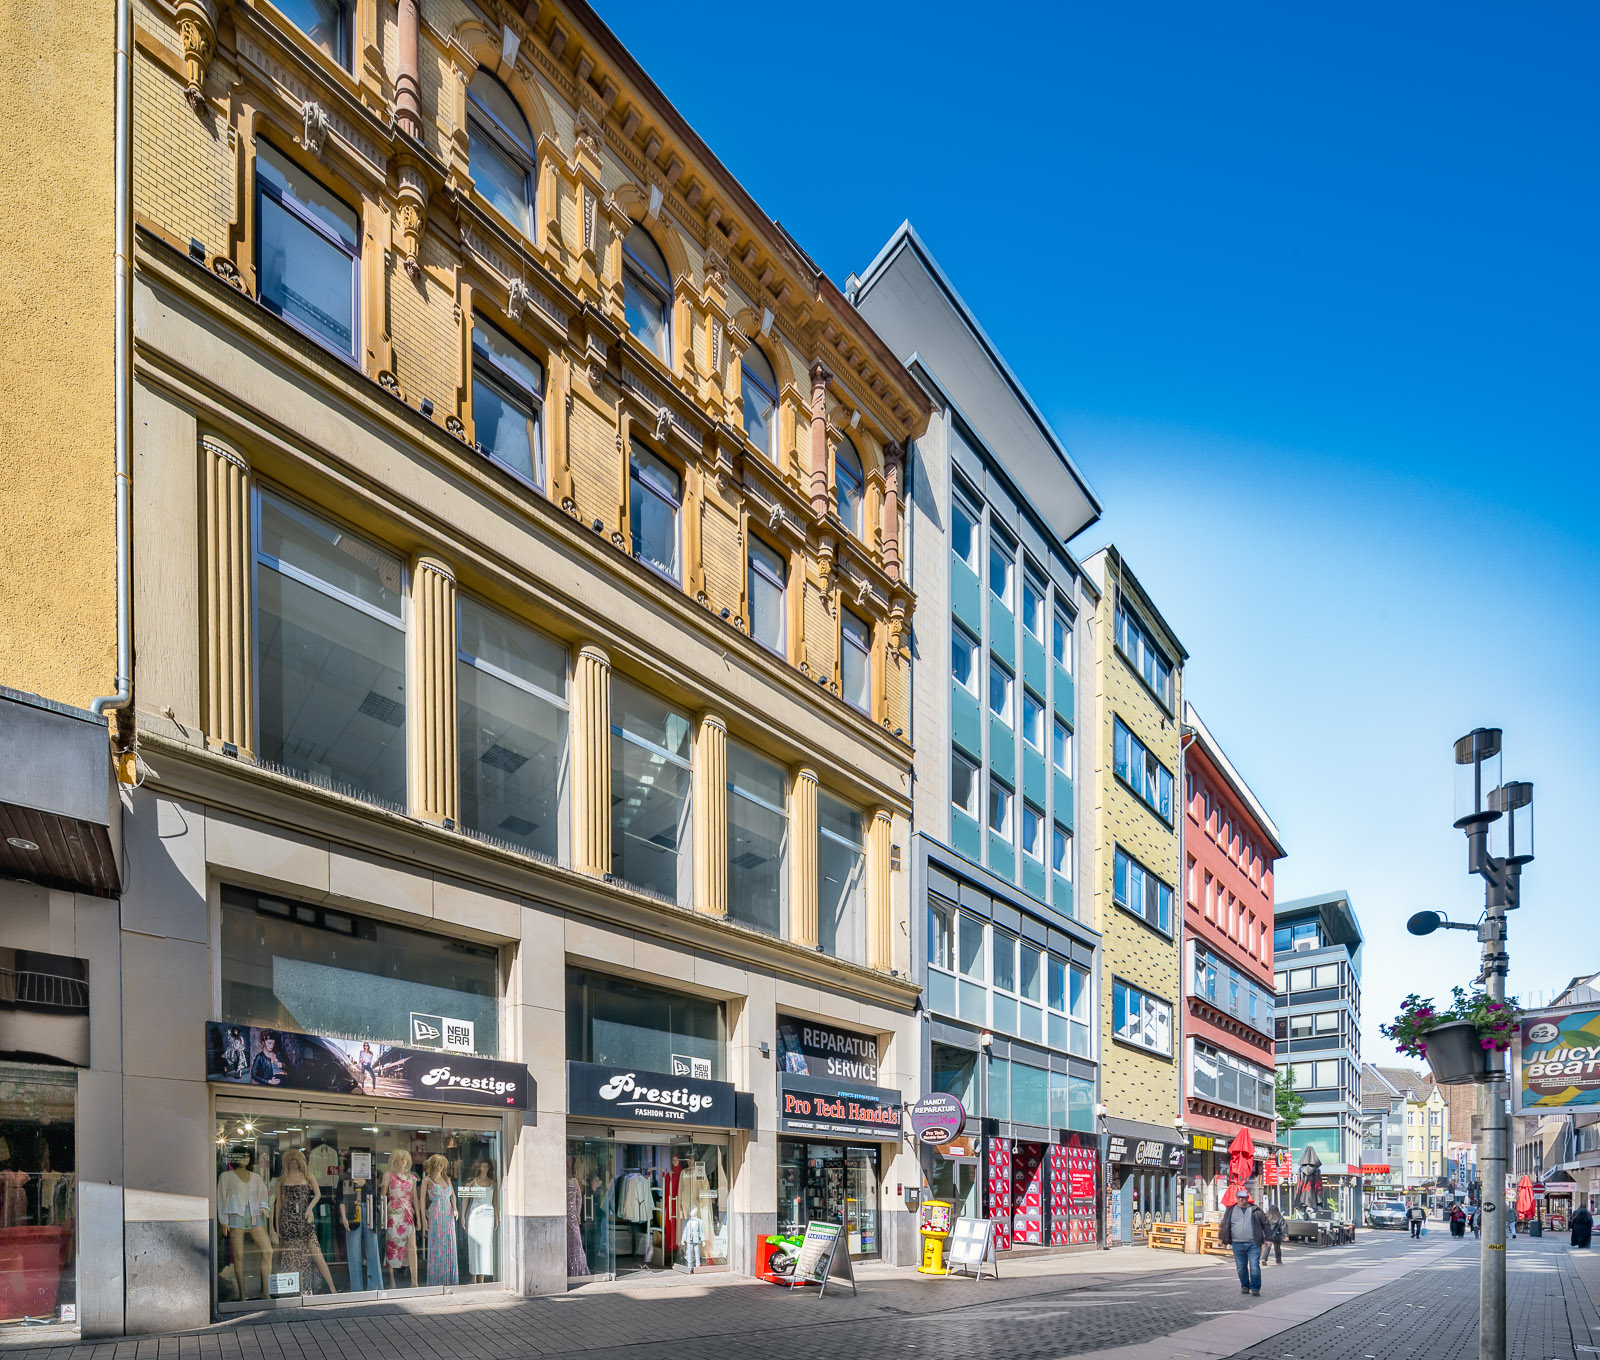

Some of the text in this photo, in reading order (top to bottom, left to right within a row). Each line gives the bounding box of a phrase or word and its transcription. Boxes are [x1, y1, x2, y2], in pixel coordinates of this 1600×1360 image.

[447, 1025, 469, 1036] NEW
[1531, 1030, 1549, 1039] 62
[447, 1035, 469, 1046] ERA
[803, 1027, 876, 1059] REPARATUR
[1522, 1045, 1600, 1065] JUICY
[694, 1063, 709, 1072] NEW
[827, 1056, 876, 1082] SERVICE
[1527, 1059, 1600, 1077] BeaT
[421, 1066, 516, 1095] Prestige
[694, 1070, 709, 1079] ERA
[598, 1072, 713, 1112] Prestige
[923, 1098, 946, 1106] HANDY
[635, 1108, 685, 1120] FASHION STYLE
[785, 1094, 811, 1115] Pro
[814, 1097, 845, 1119] Tech
[848, 1102, 898, 1125] Handels
[915, 1105, 956, 1114] REPARATUR
